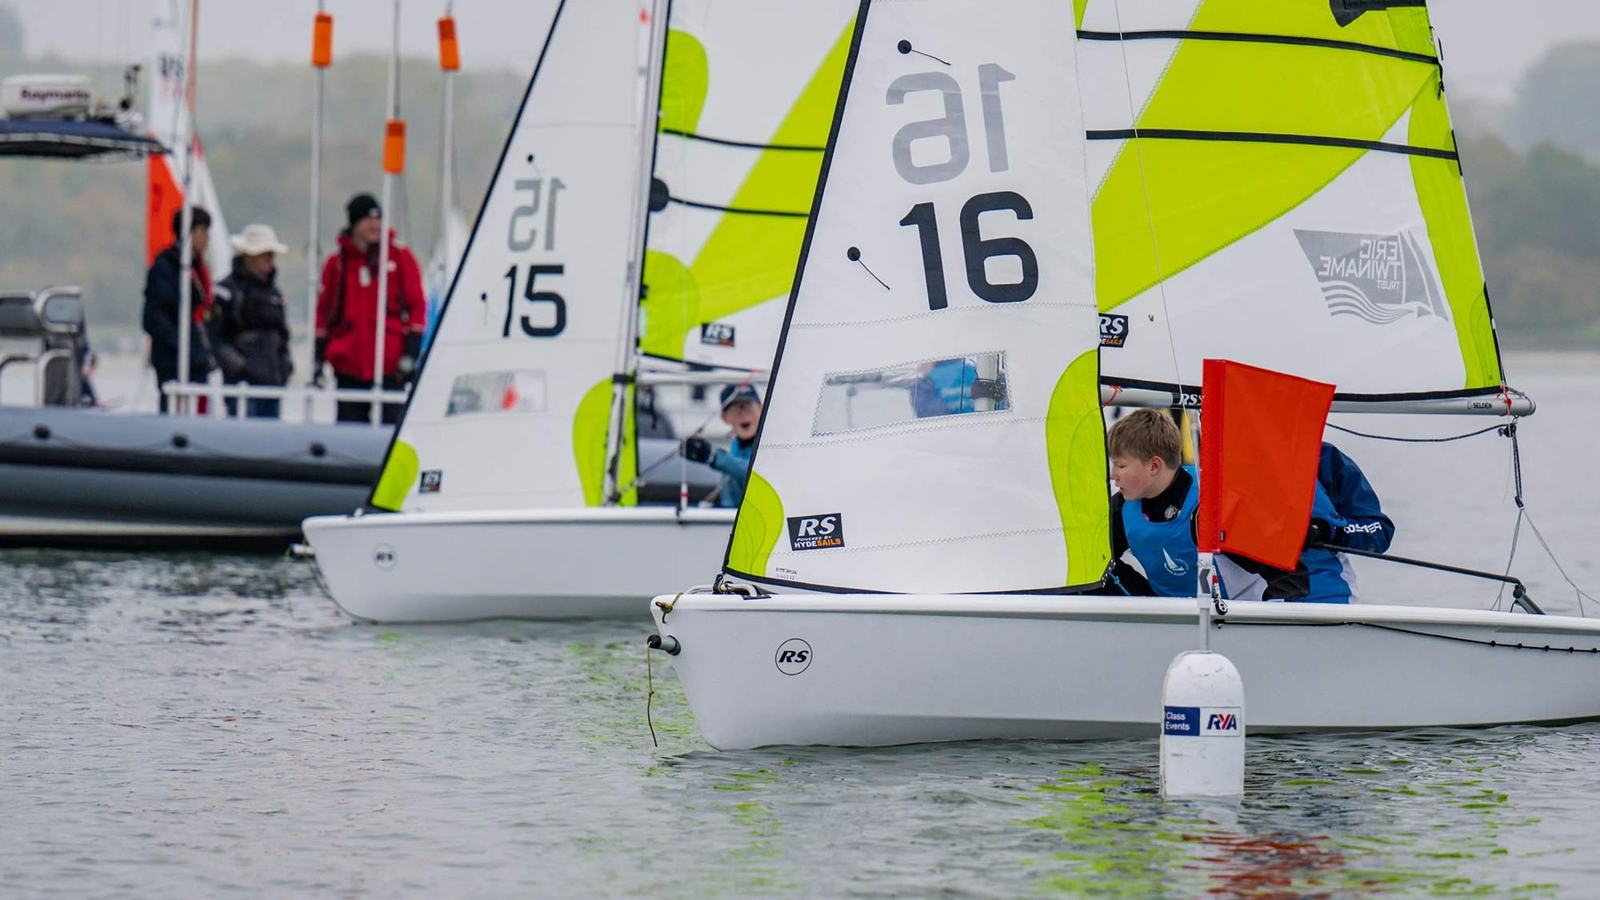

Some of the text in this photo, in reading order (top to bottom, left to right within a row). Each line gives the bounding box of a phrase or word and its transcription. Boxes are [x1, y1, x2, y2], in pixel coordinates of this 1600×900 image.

[899, 190, 1040, 311] 16
[502, 264, 567, 338] 15
[1099, 316, 1124, 334] RS
[798, 516, 836, 536] RS
[794, 538, 841, 548] HYDESAILS
[778, 650, 809, 663] RS
[1166, 712, 1186, 720] Class
[1207, 714, 1237, 730] RYA
[1166, 721, 1190, 731] Events
